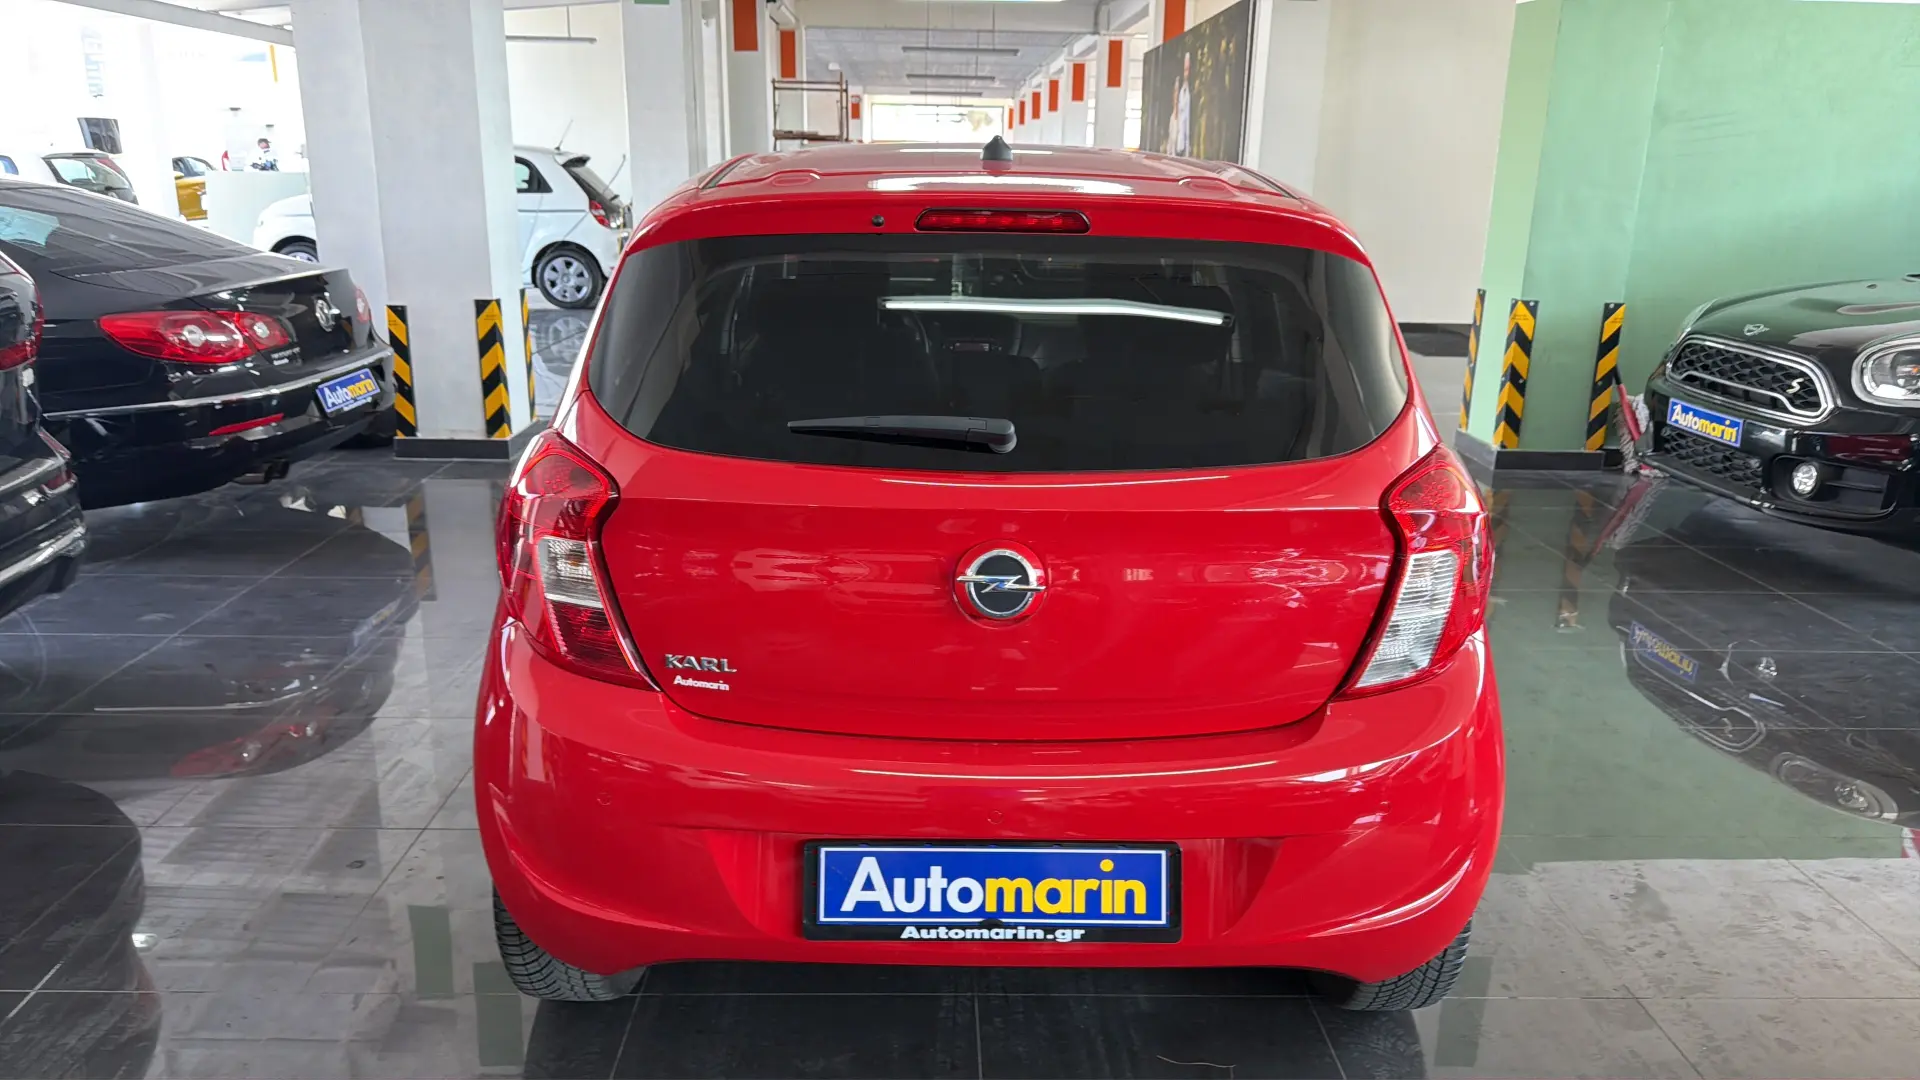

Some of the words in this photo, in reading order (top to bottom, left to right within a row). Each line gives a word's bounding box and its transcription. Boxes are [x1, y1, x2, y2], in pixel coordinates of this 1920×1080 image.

[322, 374, 376, 408] Automarin
[1670, 403, 1739, 443] Automarin
[665, 653, 738, 673] KARL
[673, 674, 730, 691] Automarin
[840, 856, 1147, 915] Automarin
[900, 925, 1086, 943] Automarin.gr
